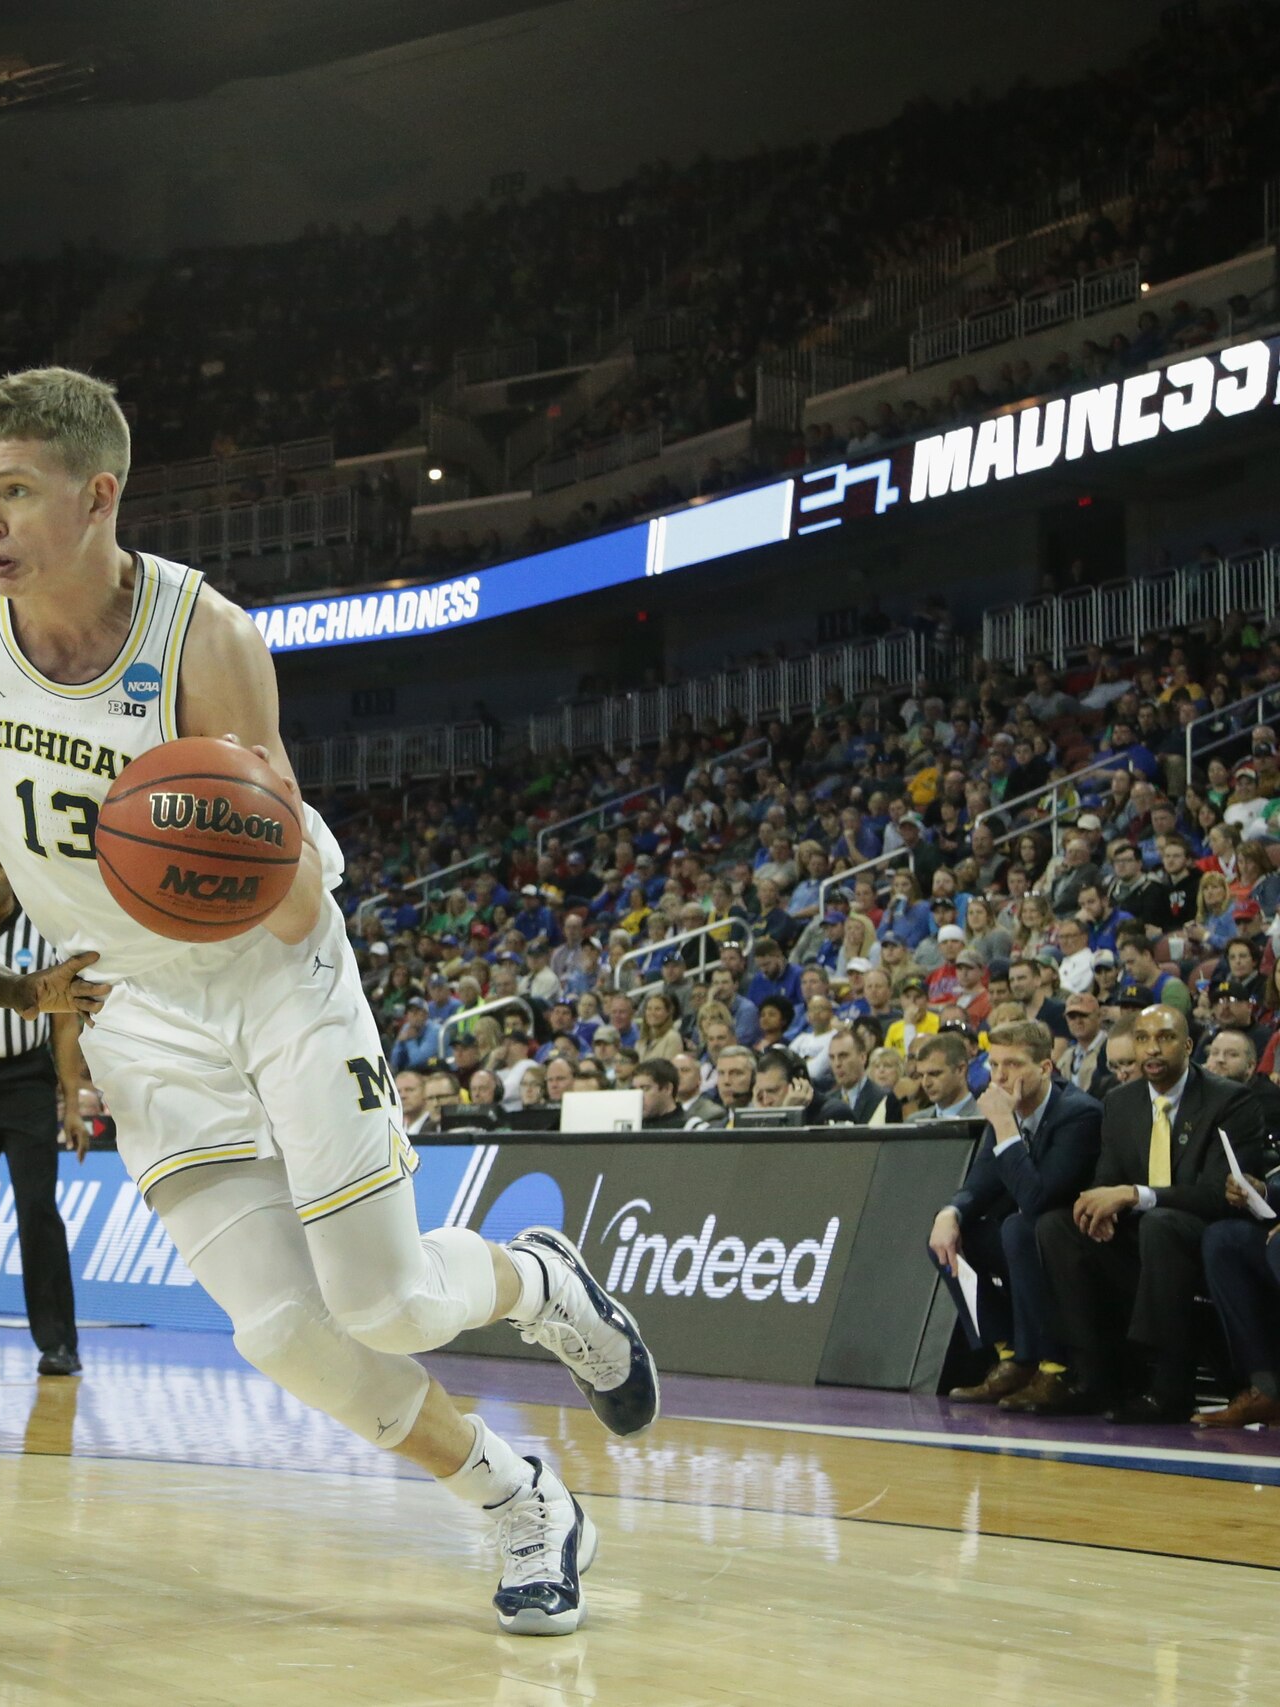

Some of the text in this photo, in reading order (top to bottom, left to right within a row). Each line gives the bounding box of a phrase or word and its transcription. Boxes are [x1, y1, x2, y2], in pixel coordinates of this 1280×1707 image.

[127, 681, 160, 692] NCAA
[14, 778, 101, 860] 13
[148, 791, 285, 849] Wilson
[159, 864, 261, 903] NCAA
[345, 1055, 398, 1112] M
[603, 1212, 841, 1304] indeed
